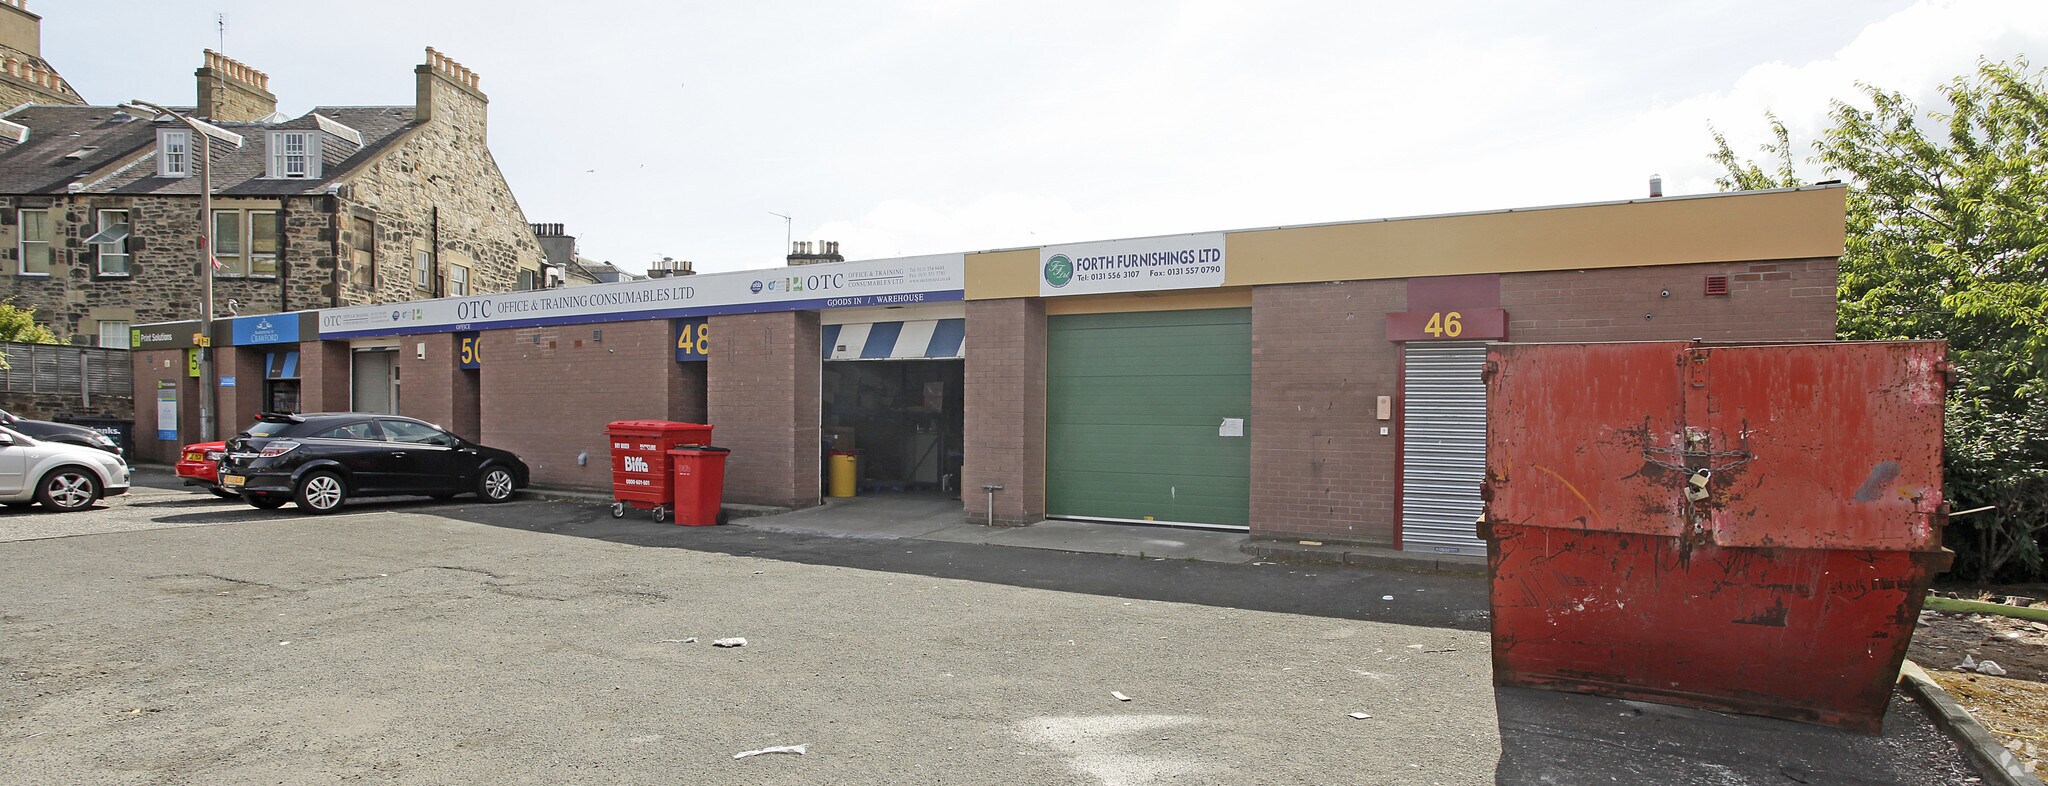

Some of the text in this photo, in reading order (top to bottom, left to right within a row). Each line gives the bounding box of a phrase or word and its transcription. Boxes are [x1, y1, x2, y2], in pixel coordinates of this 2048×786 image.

[1076, 248, 1221, 271] FORTH FURNISHINGS LTD
[807, 273, 844, 291] OTC
[1090, 273, 1106, 281] 0131
[1123, 270, 1140, 279] 3107
[1149, 269, 1165, 277] Fax:
[1167, 268, 1183, 276] 0131
[1200, 265, 1221, 274] 0790
[848, 279, 891, 287] CONSUMABLES
[457, 286, 695, 320] OTC OFFICE & TRAINING CONSUMABLES LTD
[827, 297, 852, 307] GOODS
[876, 293, 924, 303] WAREHOUSE
[323, 315, 342, 327] OTC
[1424, 312, 1462, 337] 46
[140, 334, 152, 342] Print
[151, 332, 173, 342] Solutions
[677, 323, 708, 355] 48
[624, 455, 649, 473] Biffa
